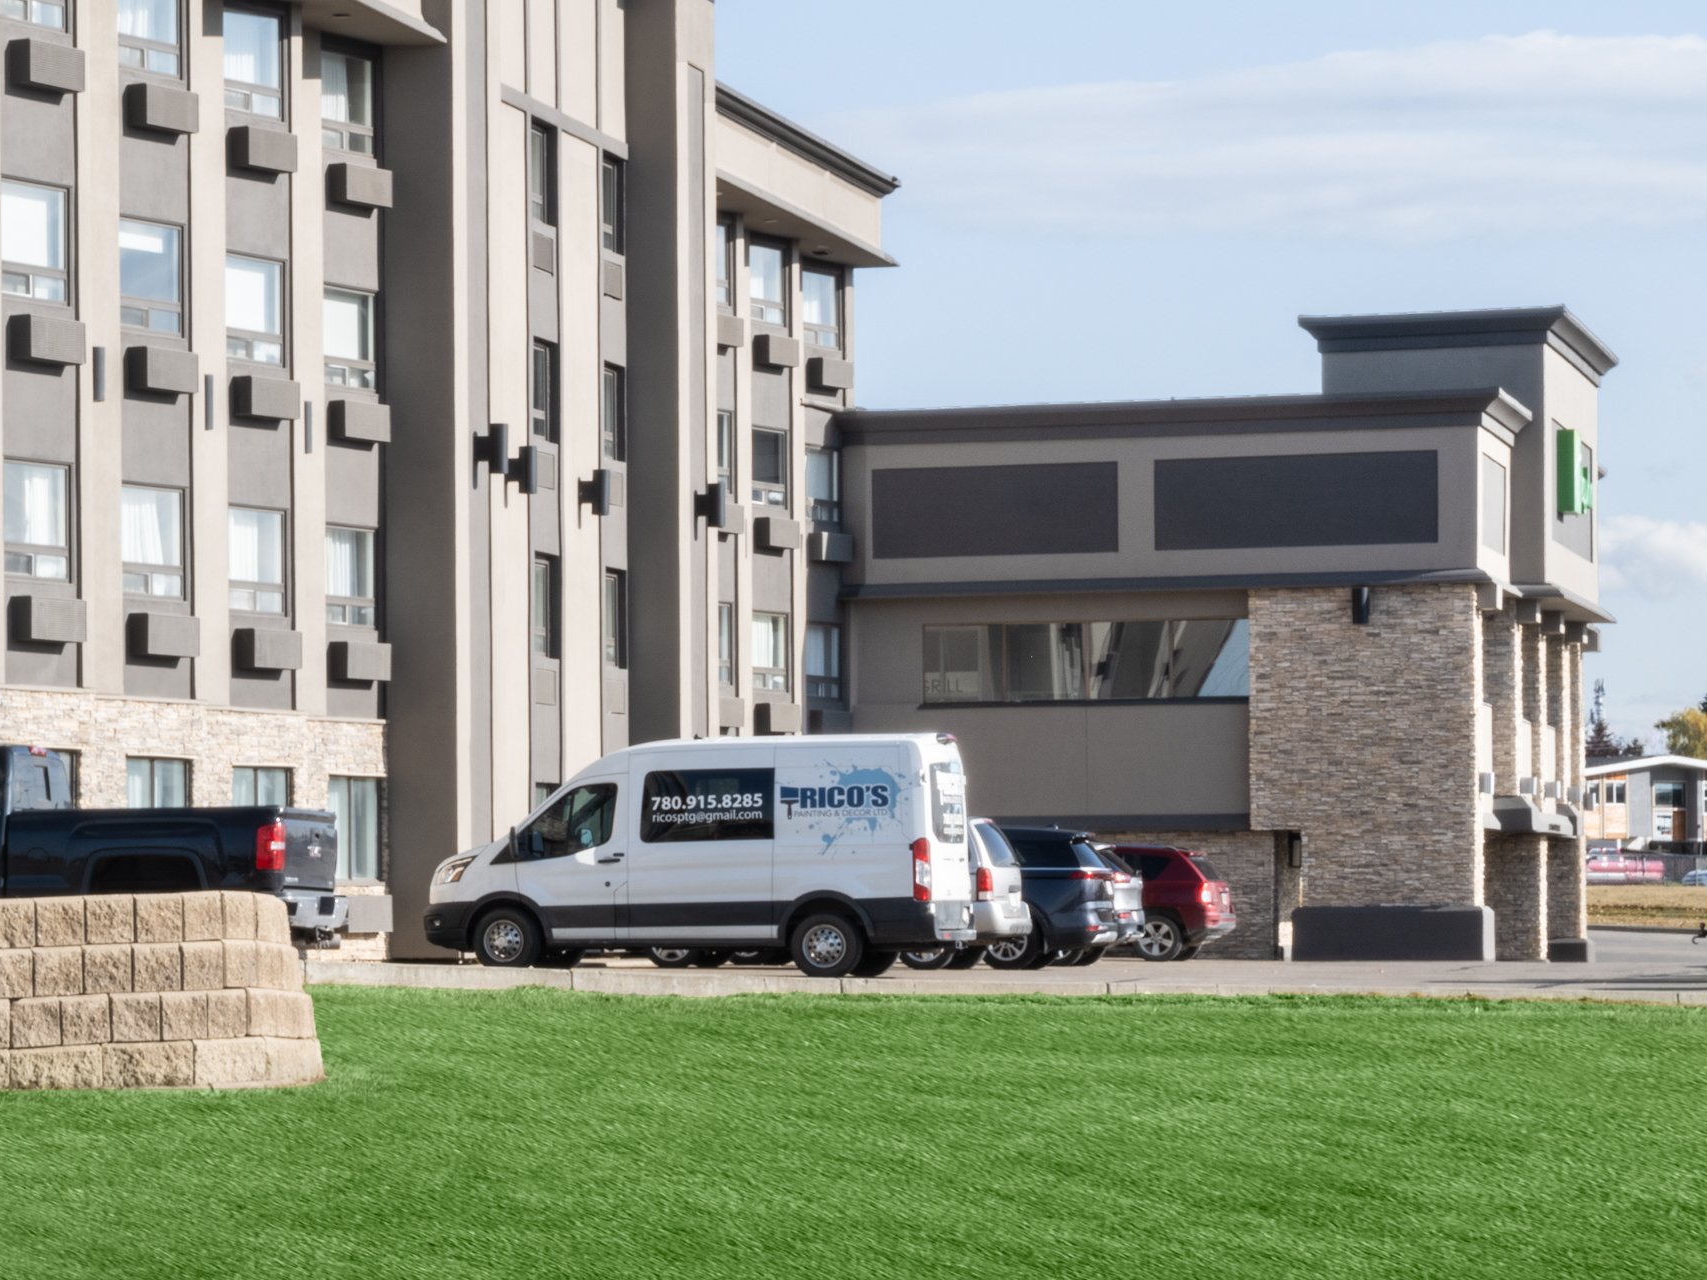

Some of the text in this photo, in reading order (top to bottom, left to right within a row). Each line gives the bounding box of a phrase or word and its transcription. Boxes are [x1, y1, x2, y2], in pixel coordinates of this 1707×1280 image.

[650, 792, 764, 812] 780.915.8285
[651, 808, 764, 825] ricosptg@gmail.com
[793, 807, 888, 818] PAINTING & DECOR LTD
